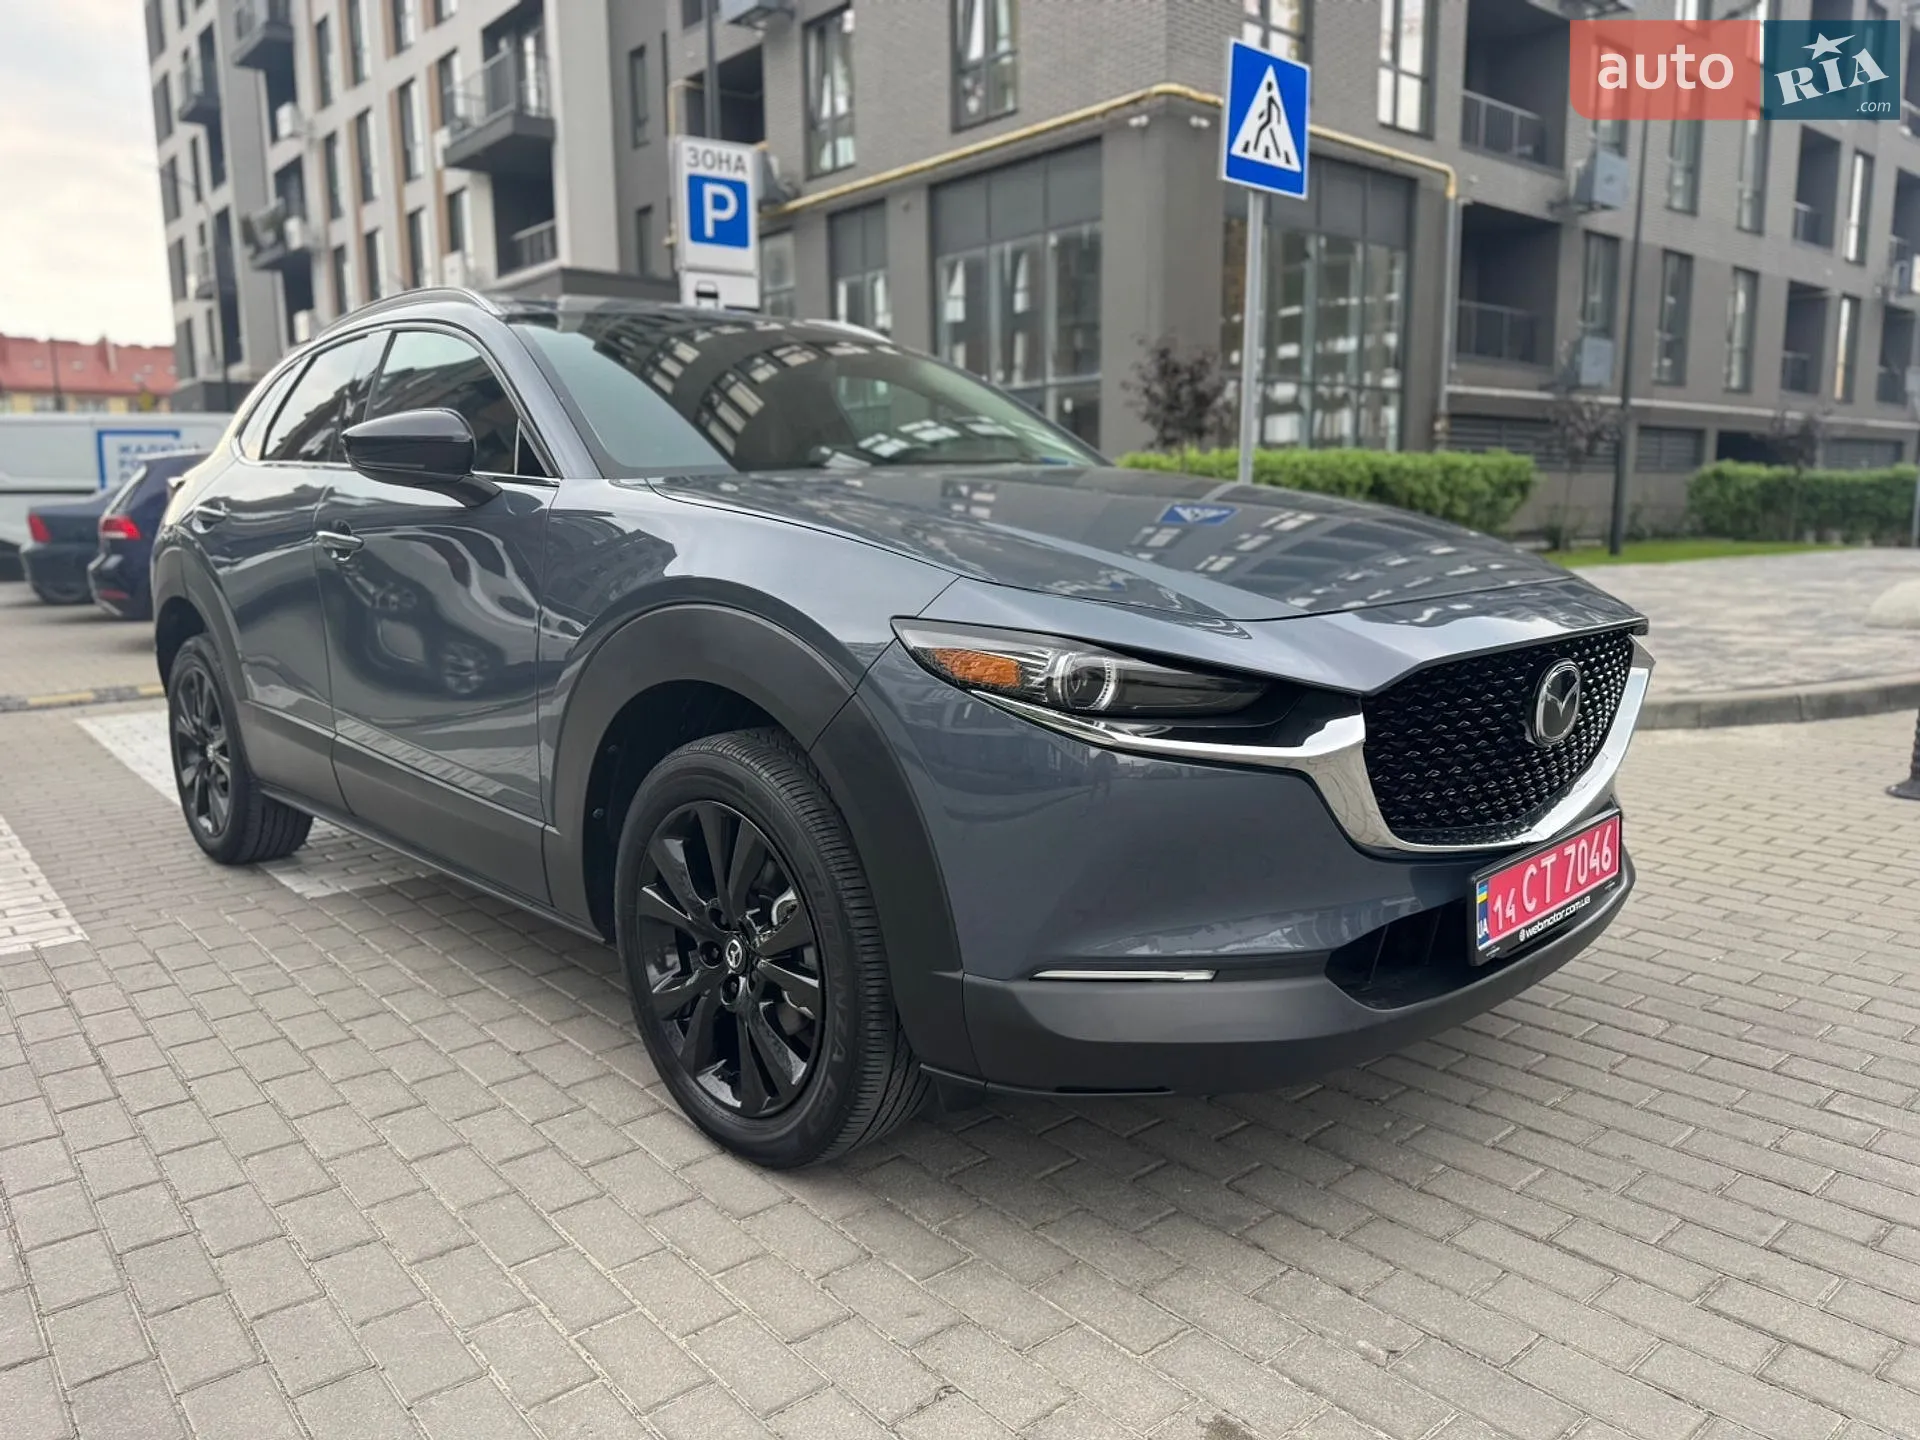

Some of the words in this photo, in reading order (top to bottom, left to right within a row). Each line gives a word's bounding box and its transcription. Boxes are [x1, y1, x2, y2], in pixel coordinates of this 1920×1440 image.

[686, 147, 748, 175] ЗОНА
[702, 182, 739, 239] P
[1493, 887, 1516, 931] 14
[1522, 853, 1557, 913] CT
[1564, 824, 1612, 893] 7046
[1478, 917, 1490, 939] UA
